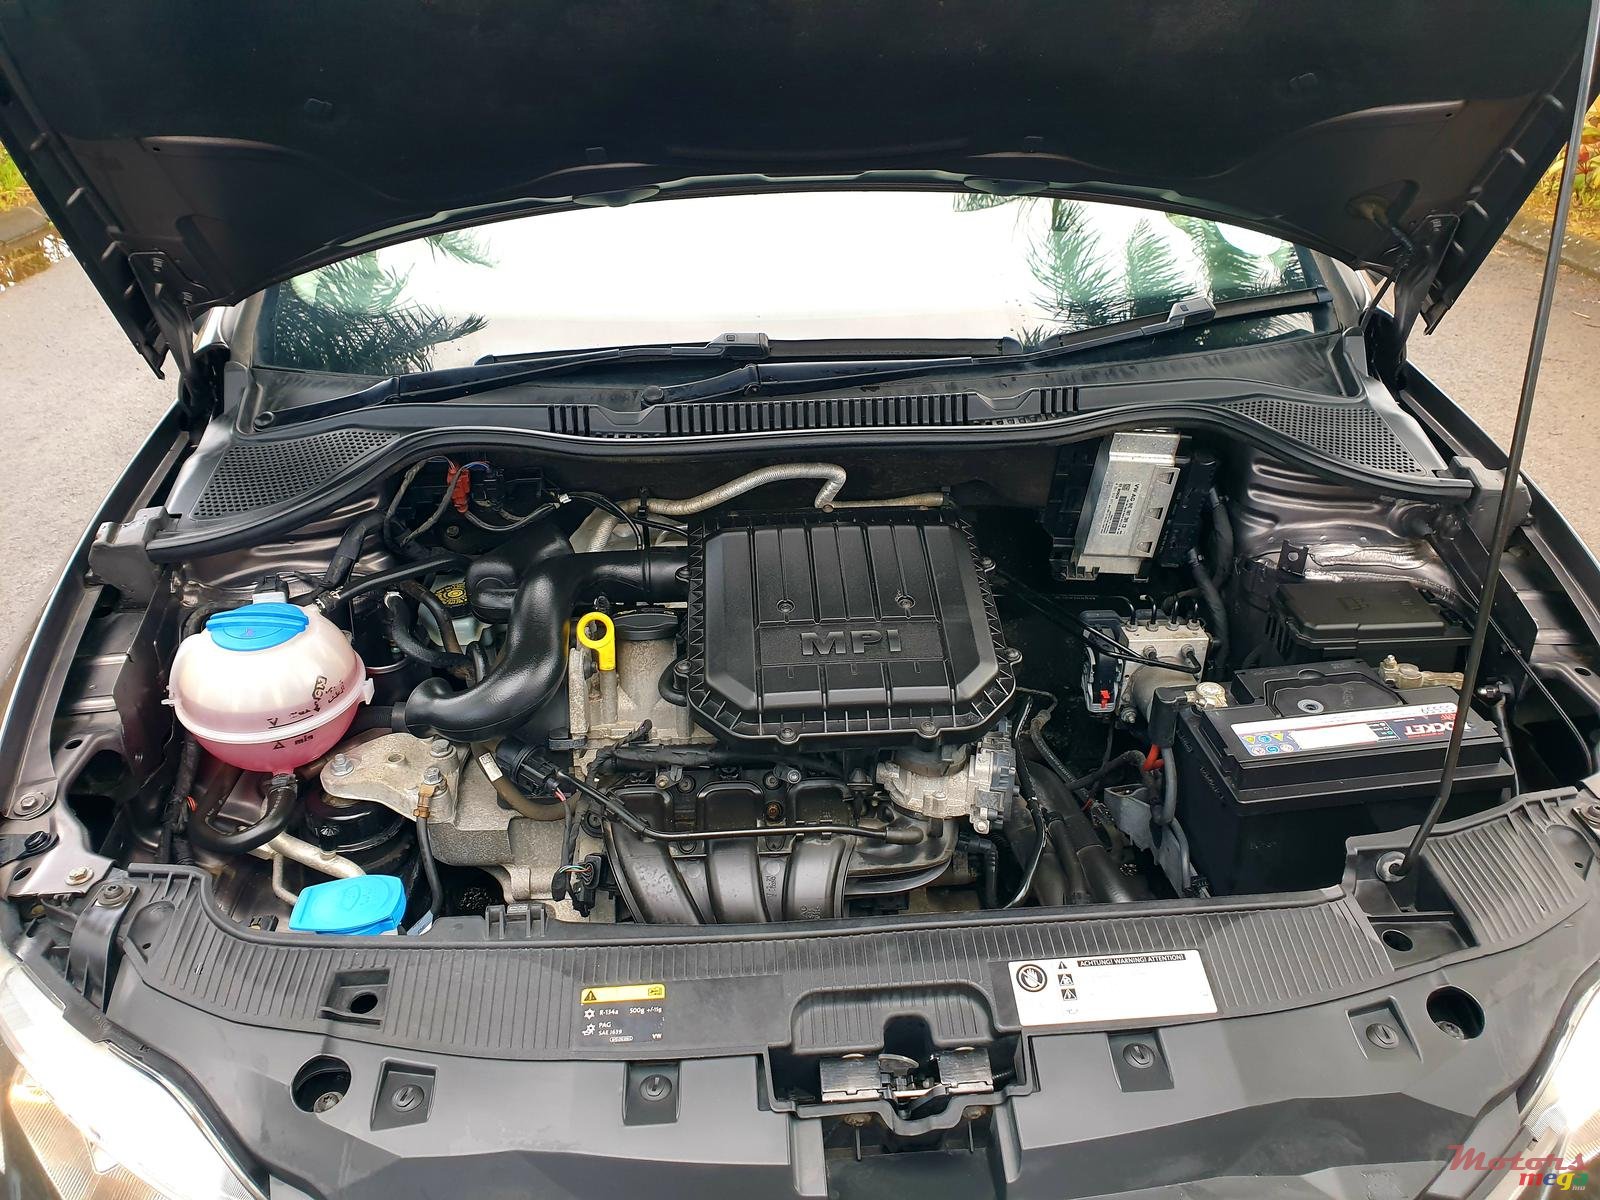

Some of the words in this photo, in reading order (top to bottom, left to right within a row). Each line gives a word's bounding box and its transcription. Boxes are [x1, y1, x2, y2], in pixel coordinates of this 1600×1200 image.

[800, 628, 902, 656] MPI
[294, 734, 314, 746] min
[1079, 958, 1113, 967] ACHTUNG!
[1114, 956, 1147, 965] WARNING!
[1148, 954, 1184, 962] ATTENTION!
[629, 1006, 645, 1015] 500g
[598, 1021, 611, 1029] PAG
